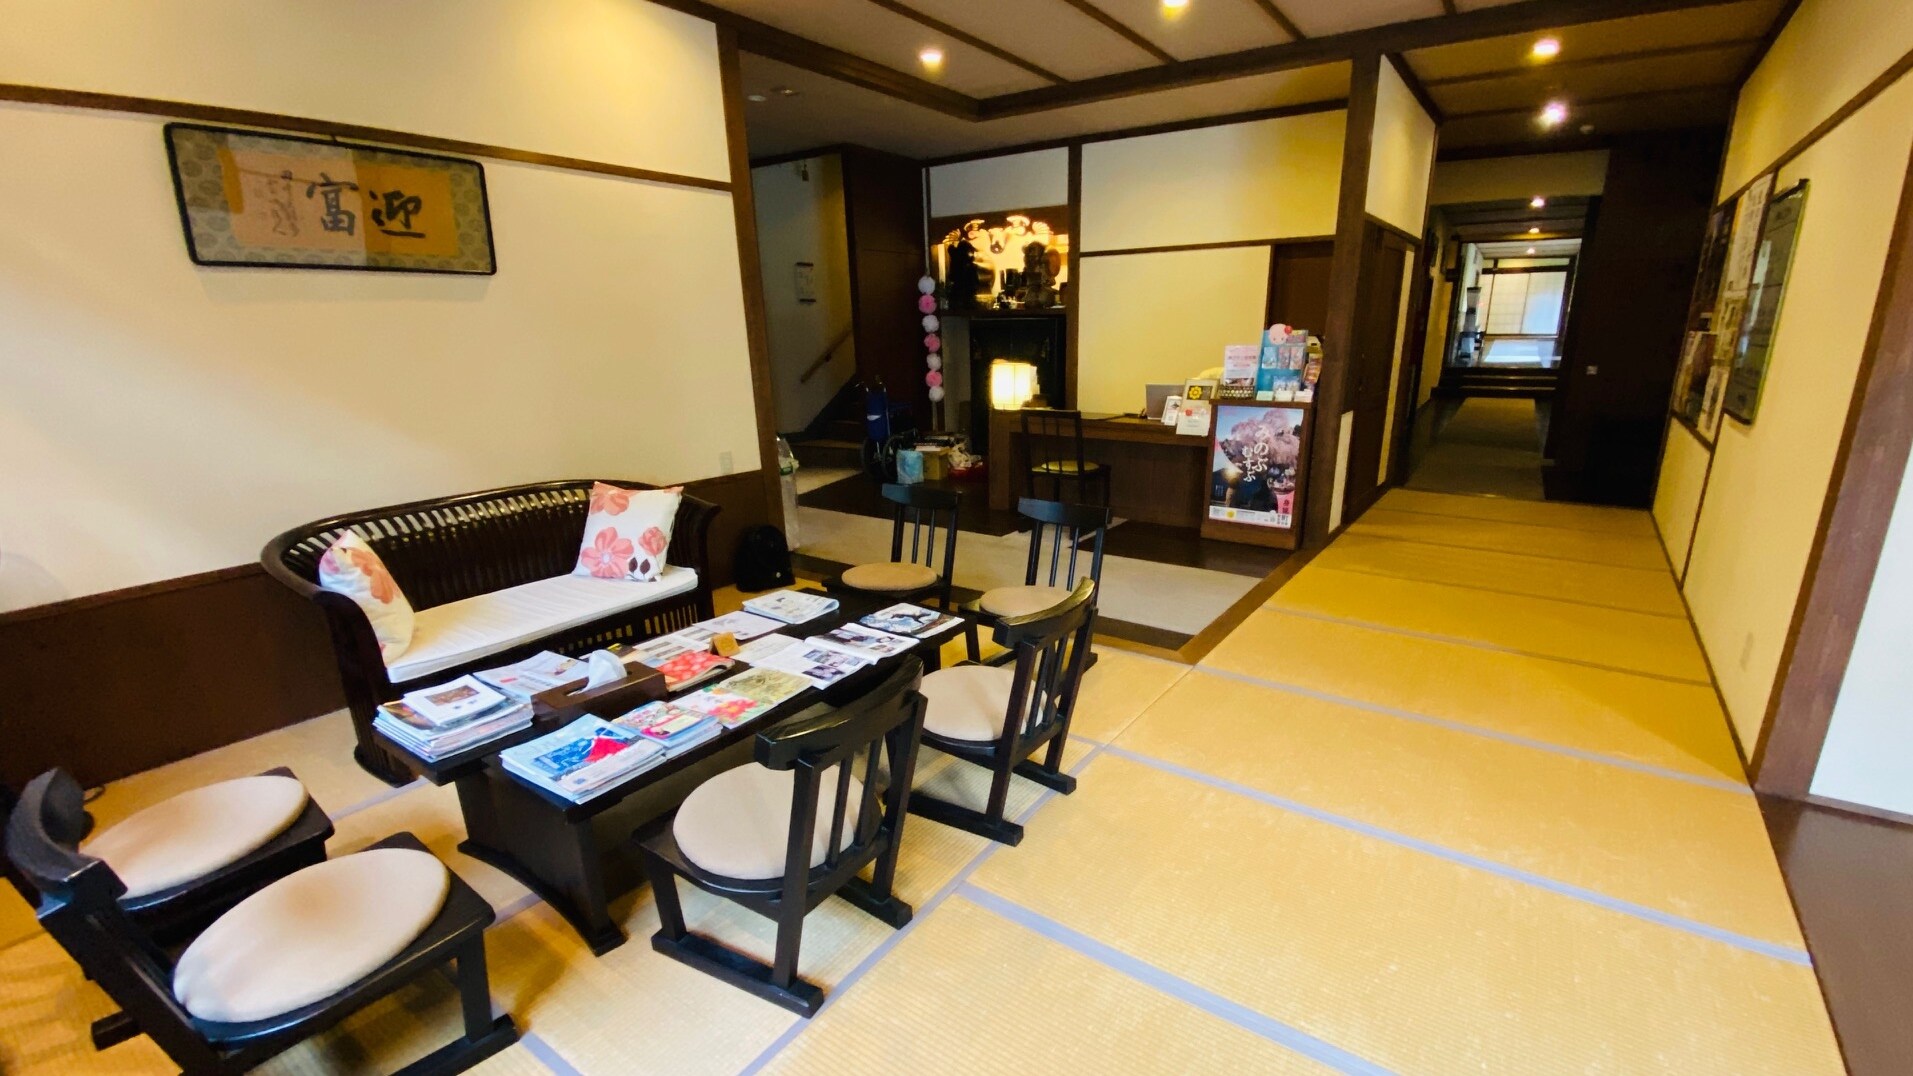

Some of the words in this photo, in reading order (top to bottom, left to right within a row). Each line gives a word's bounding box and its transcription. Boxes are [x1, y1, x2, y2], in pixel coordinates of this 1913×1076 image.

[1241, 446, 1256, 482] むすぶ
[1252, 425, 1269, 472] みのぶ
